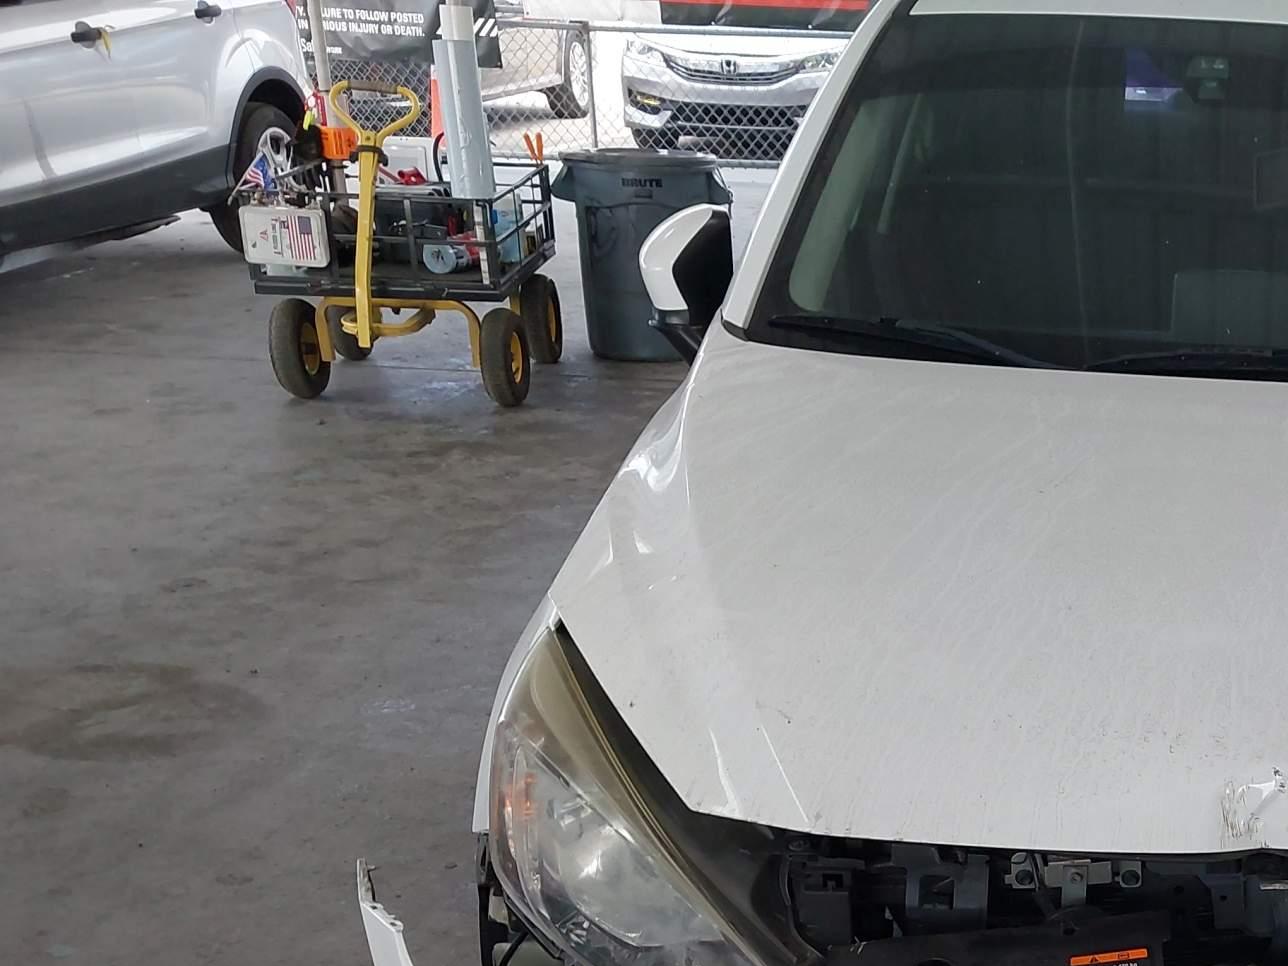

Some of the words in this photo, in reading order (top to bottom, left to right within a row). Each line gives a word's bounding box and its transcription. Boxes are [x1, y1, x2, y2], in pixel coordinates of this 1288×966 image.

[343, 8, 354, 19] TO
[355, 9, 389, 22] FOLLOW
[390, 12, 424, 23] POSTED
[298, 18, 309, 29] IN
[349, 21, 379, 34] INJURY
[381, 24, 393, 35] OR
[394, 25, 425, 36] DEATH.
